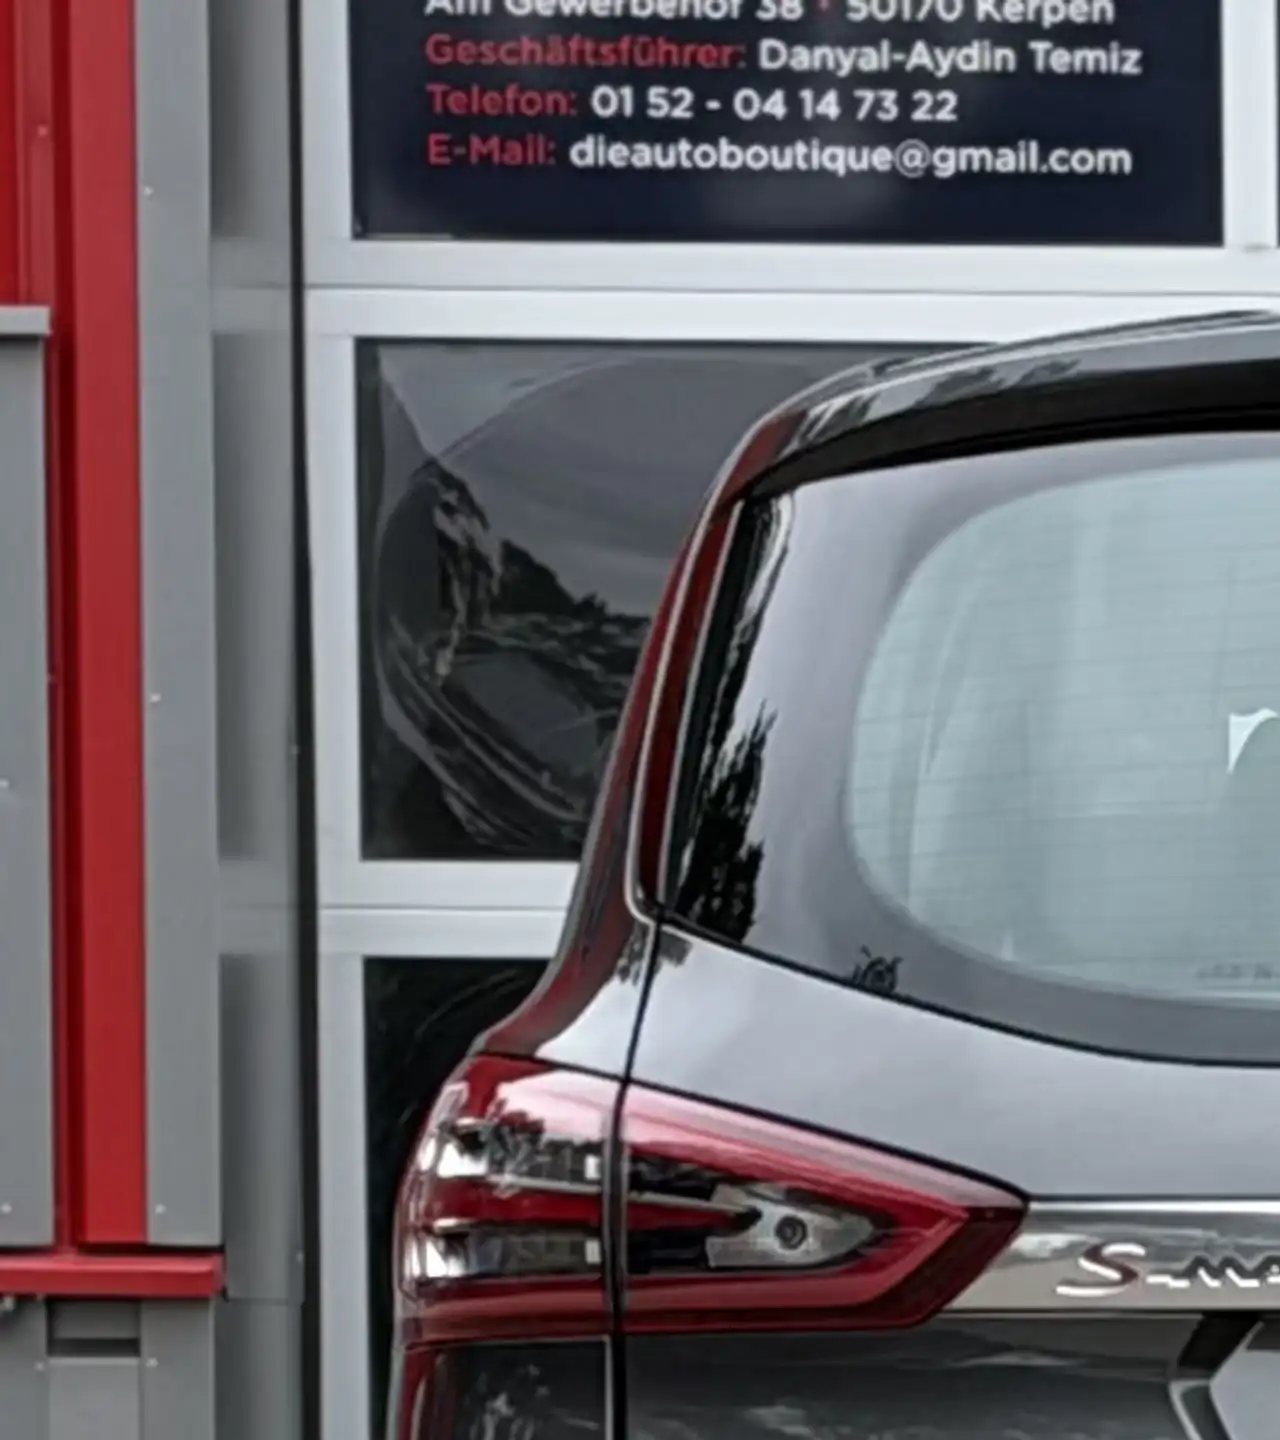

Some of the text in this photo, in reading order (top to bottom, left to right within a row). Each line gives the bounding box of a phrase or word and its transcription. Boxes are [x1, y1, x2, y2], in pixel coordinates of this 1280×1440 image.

[975, 0, 1115, 28] Kerpen
[425, 33, 1143, 78] Geschäftsführer: Danyal-Aydin Temiz
[426, 83, 958, 121] Telefon: 01 52 - 04 14 73 22
[427, 133, 1132, 178] E-Mail: dieautoboutique@gmail.com
